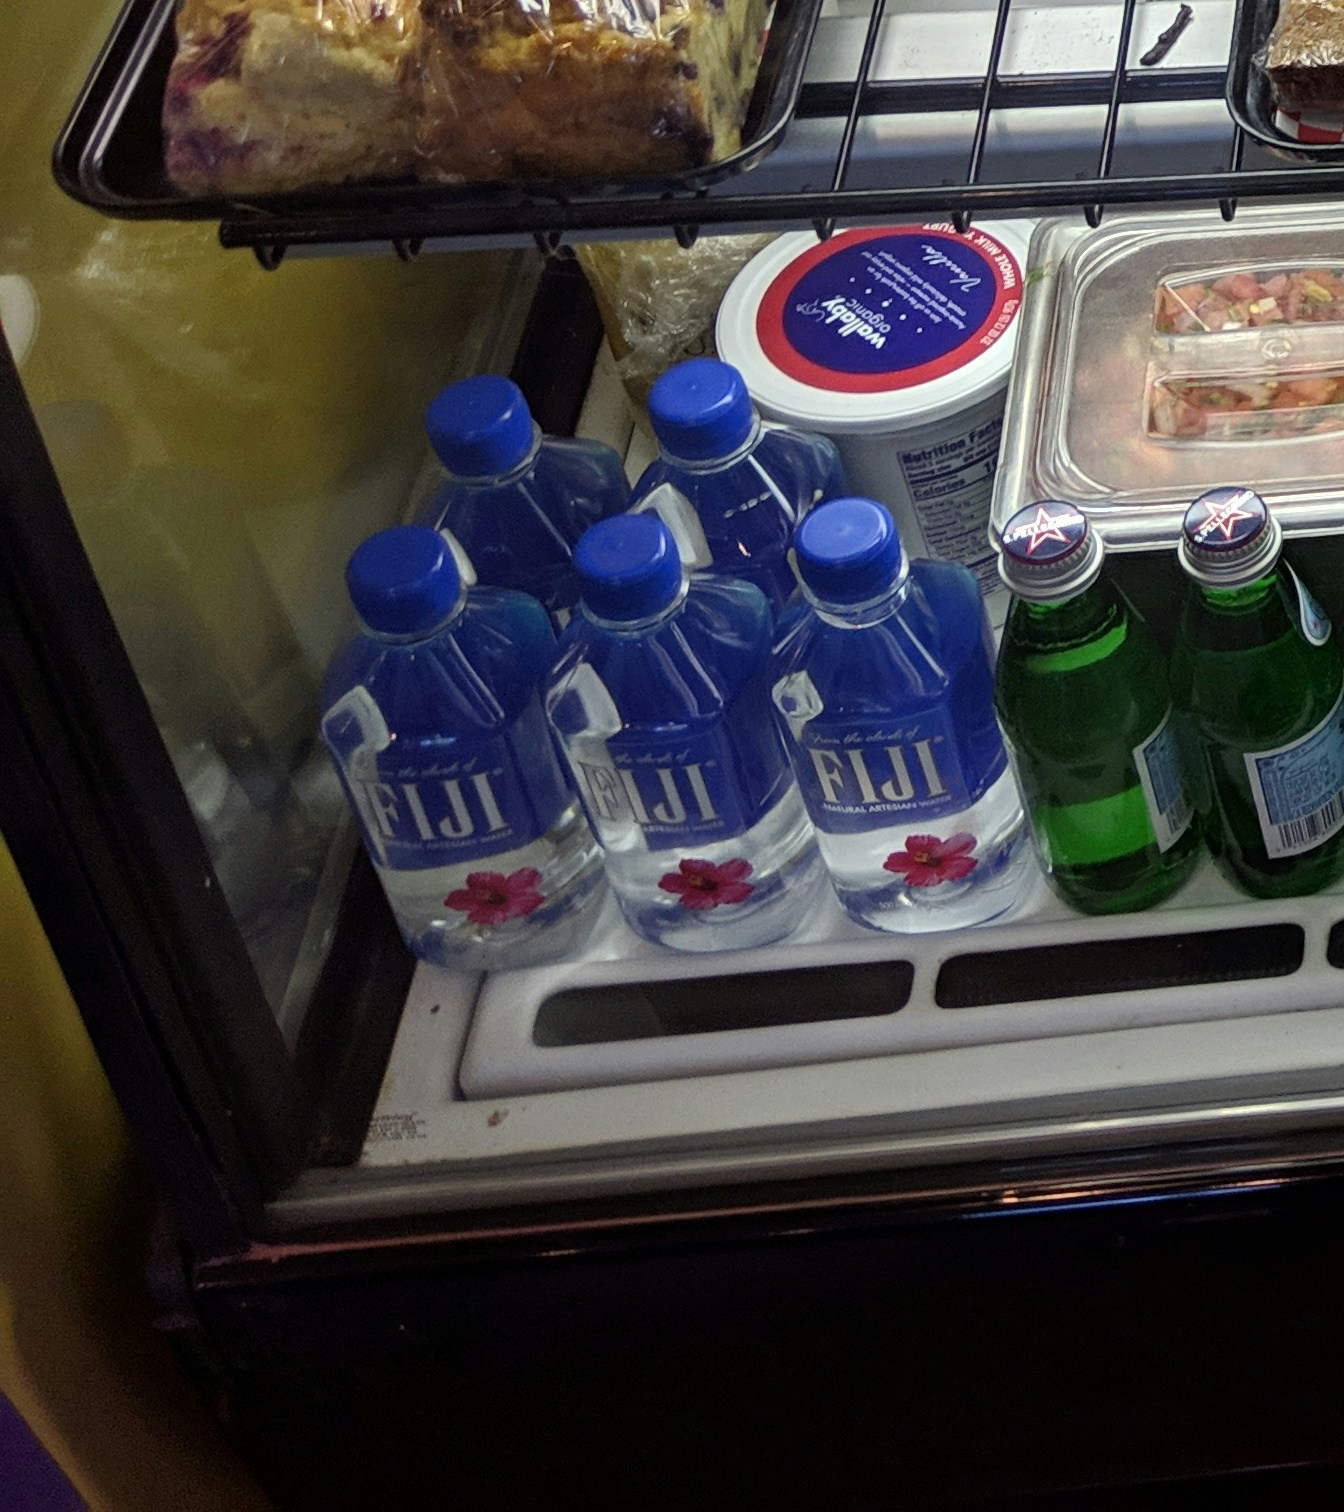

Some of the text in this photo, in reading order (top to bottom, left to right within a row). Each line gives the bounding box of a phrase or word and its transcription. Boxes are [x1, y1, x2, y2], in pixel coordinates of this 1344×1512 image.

[921, 244, 981, 292] Vanilla
[821, 297, 887, 349] wallaby
[845, 298, 891, 334] organic
[902, 438, 967, 465] Nutrition
[968, 417, 1003, 443] Fact
[913, 478, 966, 499] Calories
[578, 761, 721, 825] FIJI
[807, 737, 948, 805] FIJI
[364, 772, 511, 841] FIJI
[822, 801, 868, 815] NATURAL
[868, 799, 919, 814] ARTESIAN
